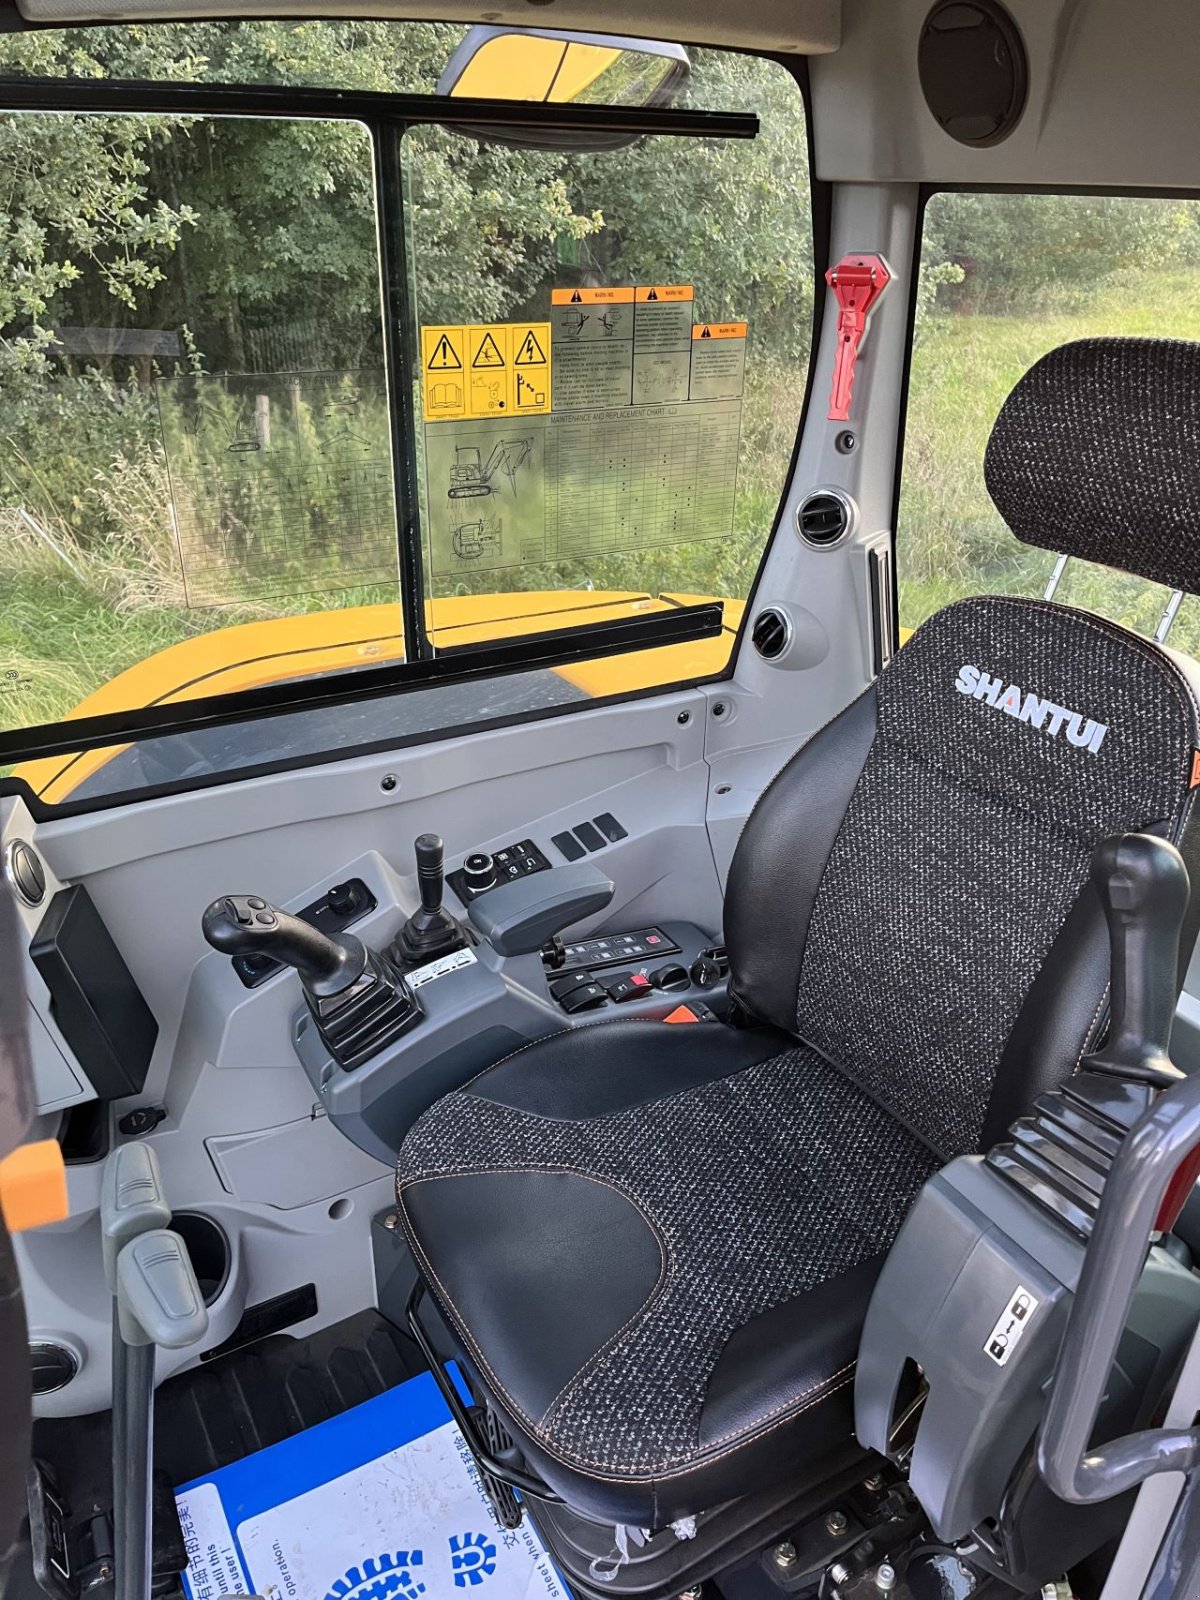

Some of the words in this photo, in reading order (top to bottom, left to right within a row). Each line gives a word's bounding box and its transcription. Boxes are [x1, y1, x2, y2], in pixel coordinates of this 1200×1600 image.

[550, 413, 591, 424] MAINTENANCE
[592, 412, 604, 420] AND
[605, 409, 646, 419] REPLACEMENT
[646, 407, 665, 416] CHART
[954, 664, 1108, 754] SHANTUI
[207, 1544, 220, 1567] this
[225, 1555, 240, 1580] user
[212, 1567, 228, 1594] until
[536, 1562, 560, 1597] sheet
